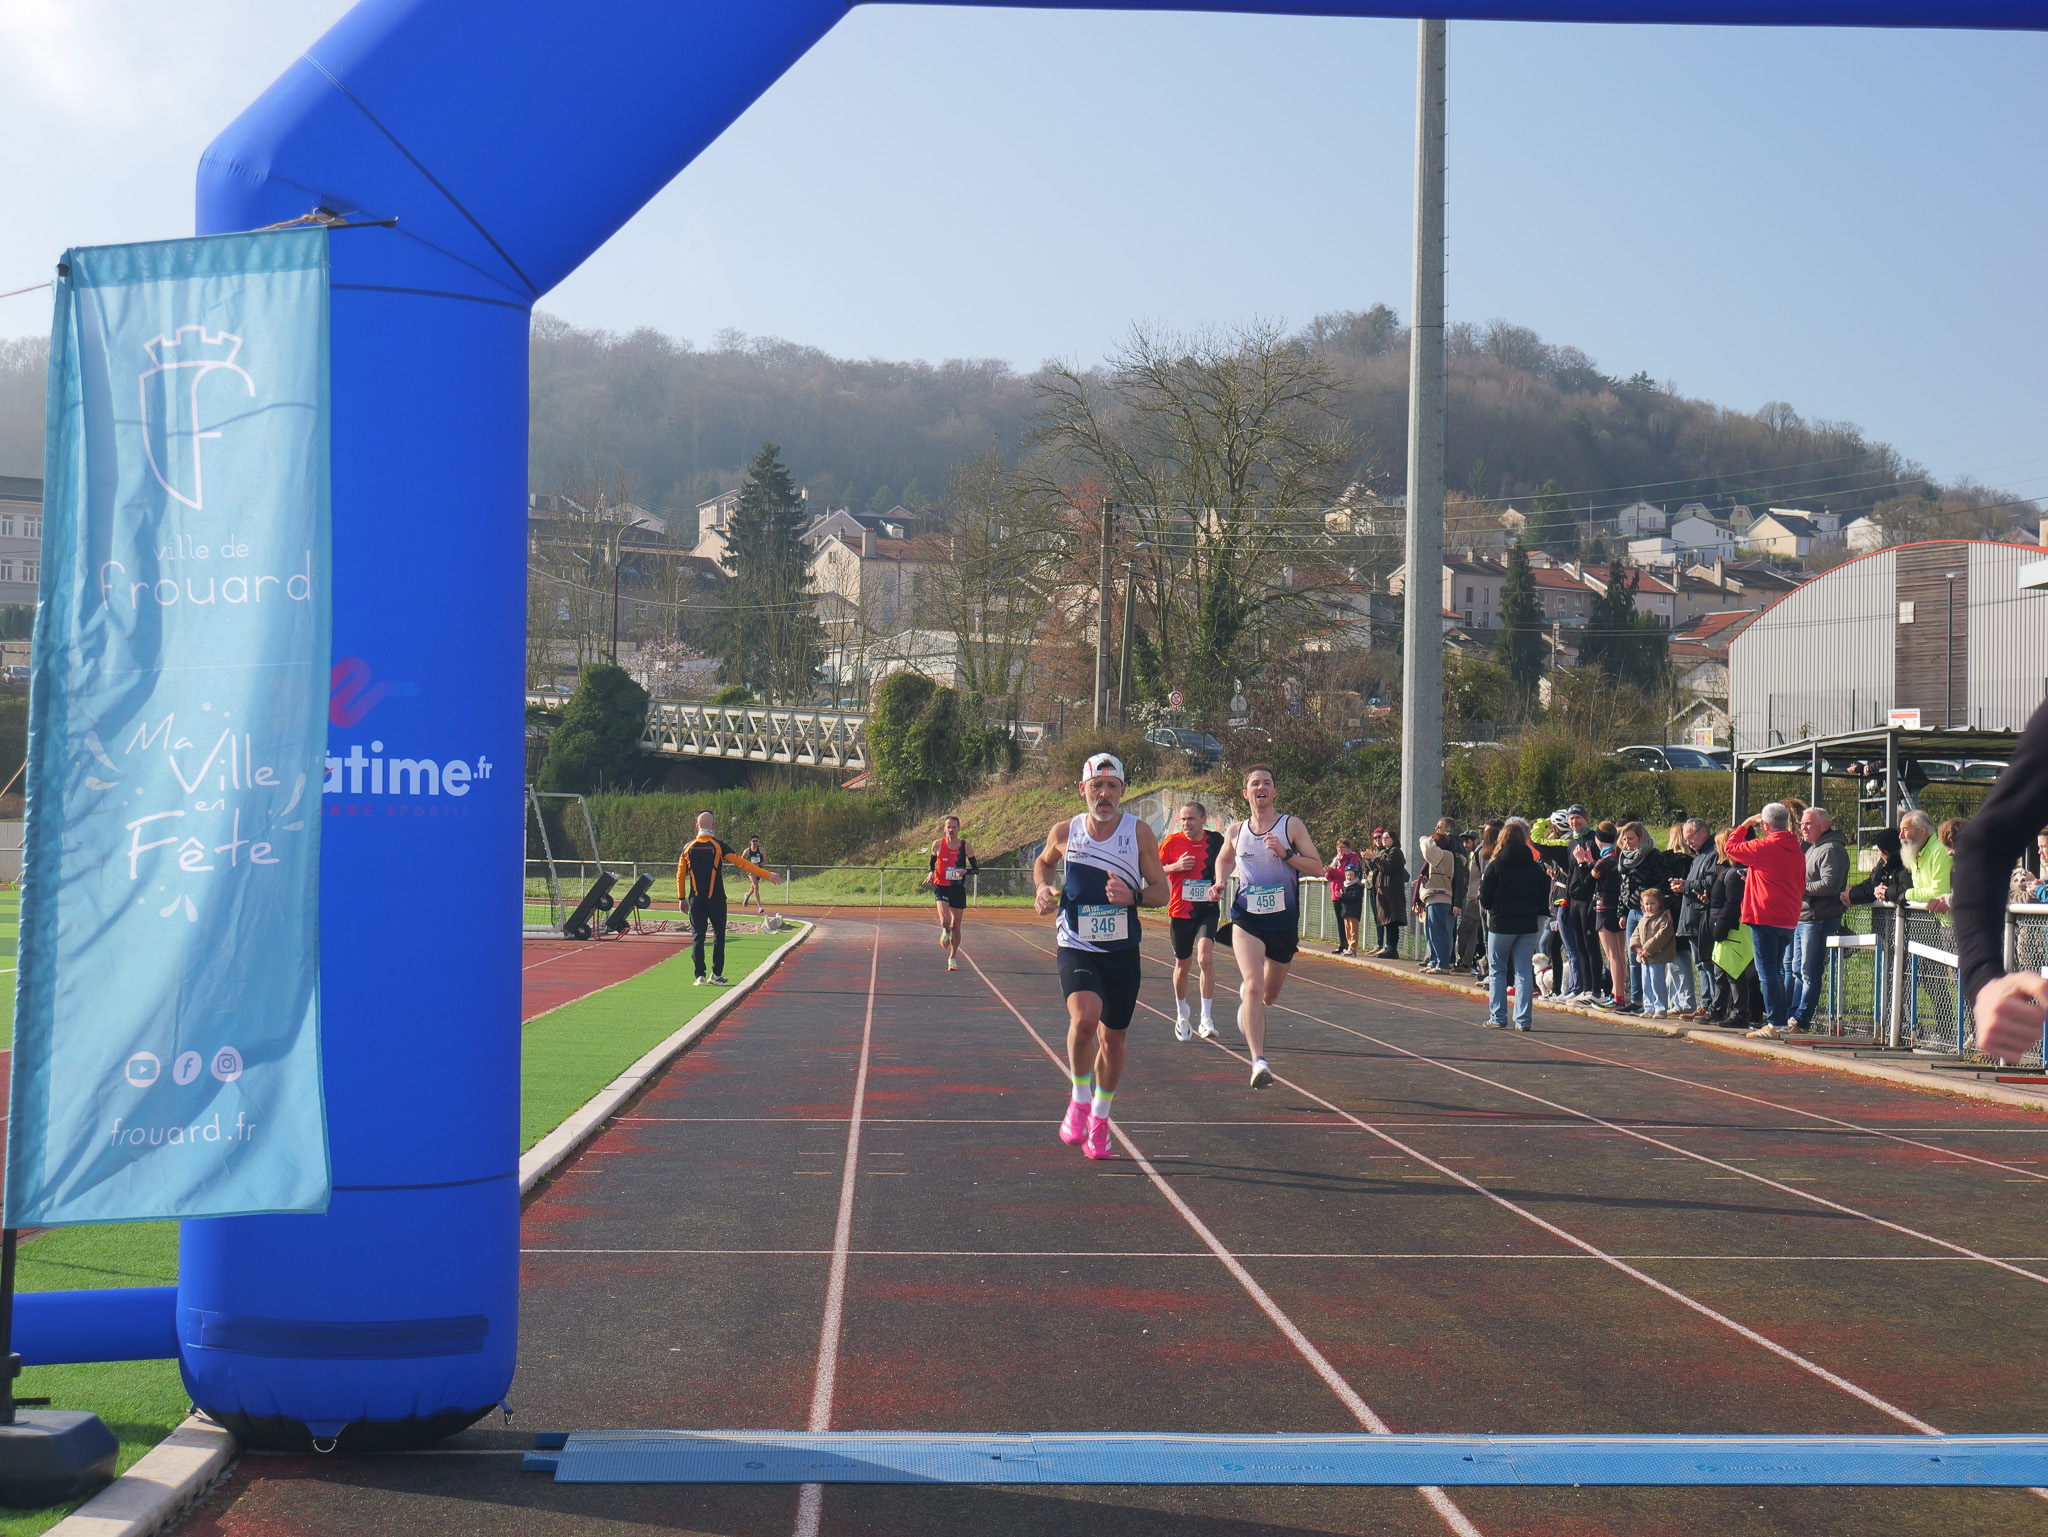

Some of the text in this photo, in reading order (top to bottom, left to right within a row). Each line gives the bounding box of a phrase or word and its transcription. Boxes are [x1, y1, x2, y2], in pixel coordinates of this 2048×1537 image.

[153, 533, 250, 560] ville de
[101, 550, 311, 611] frouard
[126, 712, 194, 755] Ma
[169, 727, 281, 794] Ville
[195, 798, 225, 812] en
[387, 804, 470, 818] SPORTIF
[126, 807, 281, 881] Fête
[1190, 887, 1205, 897] 498
[1256, 894, 1276, 908] 458
[1091, 917, 1116, 934] 346
[111, 1111, 257, 1147] frouard.fr
